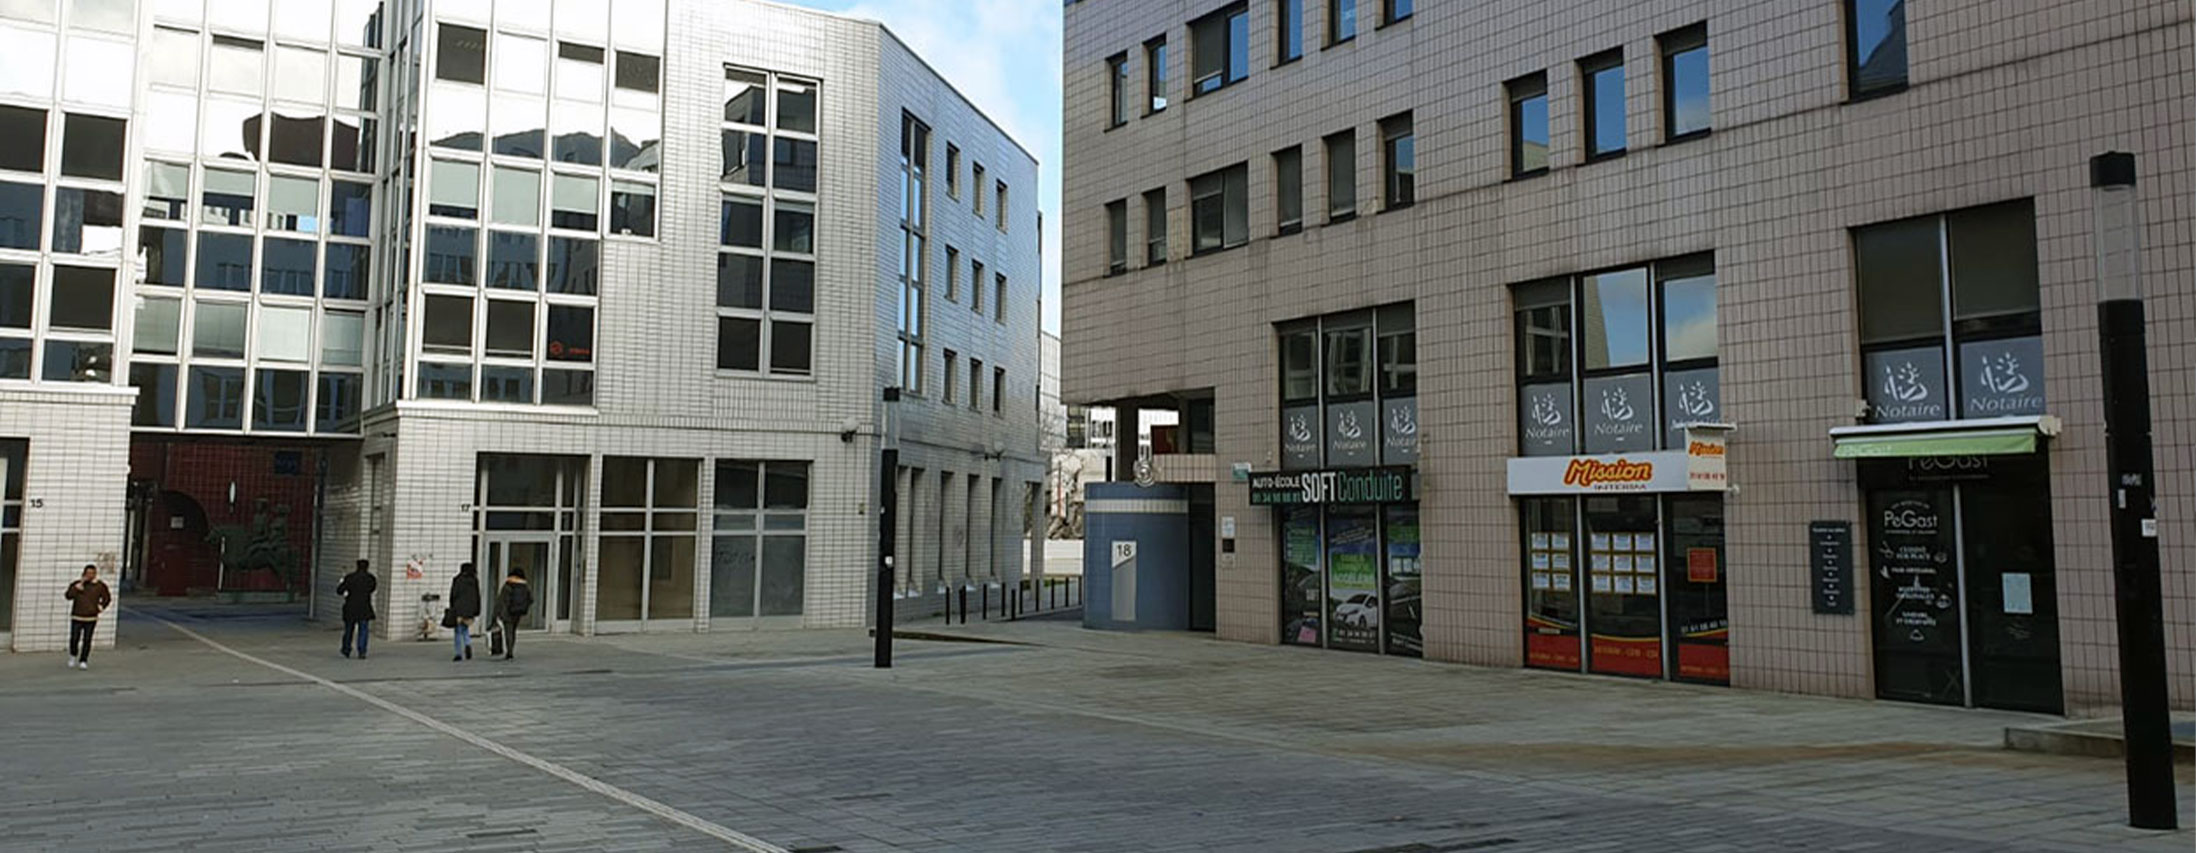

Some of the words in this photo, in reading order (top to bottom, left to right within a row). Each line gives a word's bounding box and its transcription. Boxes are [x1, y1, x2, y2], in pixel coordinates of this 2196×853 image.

[1970, 395, 2043, 412] Notaire
[1875, 402, 1941, 419] Notaire
[1525, 426, 1569, 439] Notaire
[1594, 423, 1643, 436] Notaire
[1333, 439, 1367, 450] Notaire
[1564, 458, 1652, 486] Mission
[1252, 473, 1300, 489] AUTO-ÉCOLE
[30, 498, 44, 508] 15
[461, 503, 471, 512] 17
[1883, 509, 1938, 528] PeGast
[1116, 544, 1132, 557] 18
